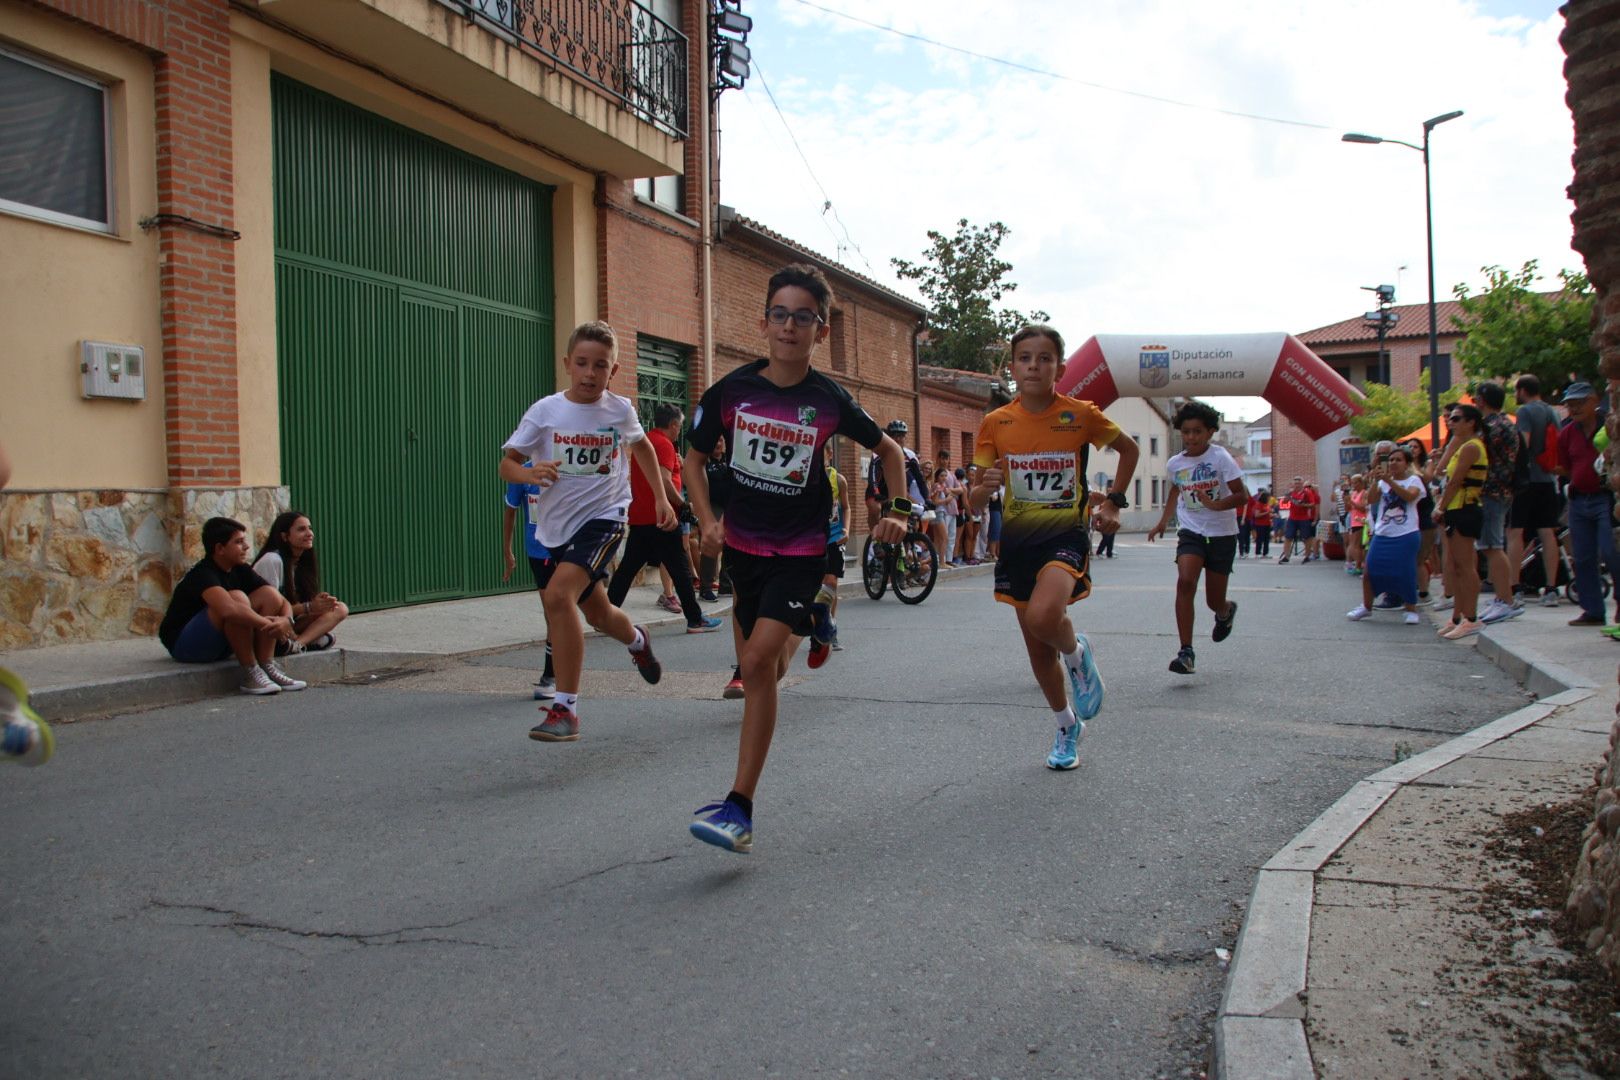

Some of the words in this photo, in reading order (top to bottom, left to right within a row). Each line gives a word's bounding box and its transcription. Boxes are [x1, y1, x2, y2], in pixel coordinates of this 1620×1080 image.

[1172, 349, 1233, 361] Diputación
[1172, 371, 1181, 380] de
[1186, 369, 1245, 380] Salamanca
[1286, 357, 1307, 376] CON
[1280, 370, 1341, 423] DEPORTISTAS
[554, 432, 613, 447] bedunia
[737, 415, 815, 447] bedunia
[565, 447, 601, 465] 160
[748, 438, 796, 468] 159
[1010, 458, 1075, 471] bedunia
[1024, 472, 1064, 491] 172
